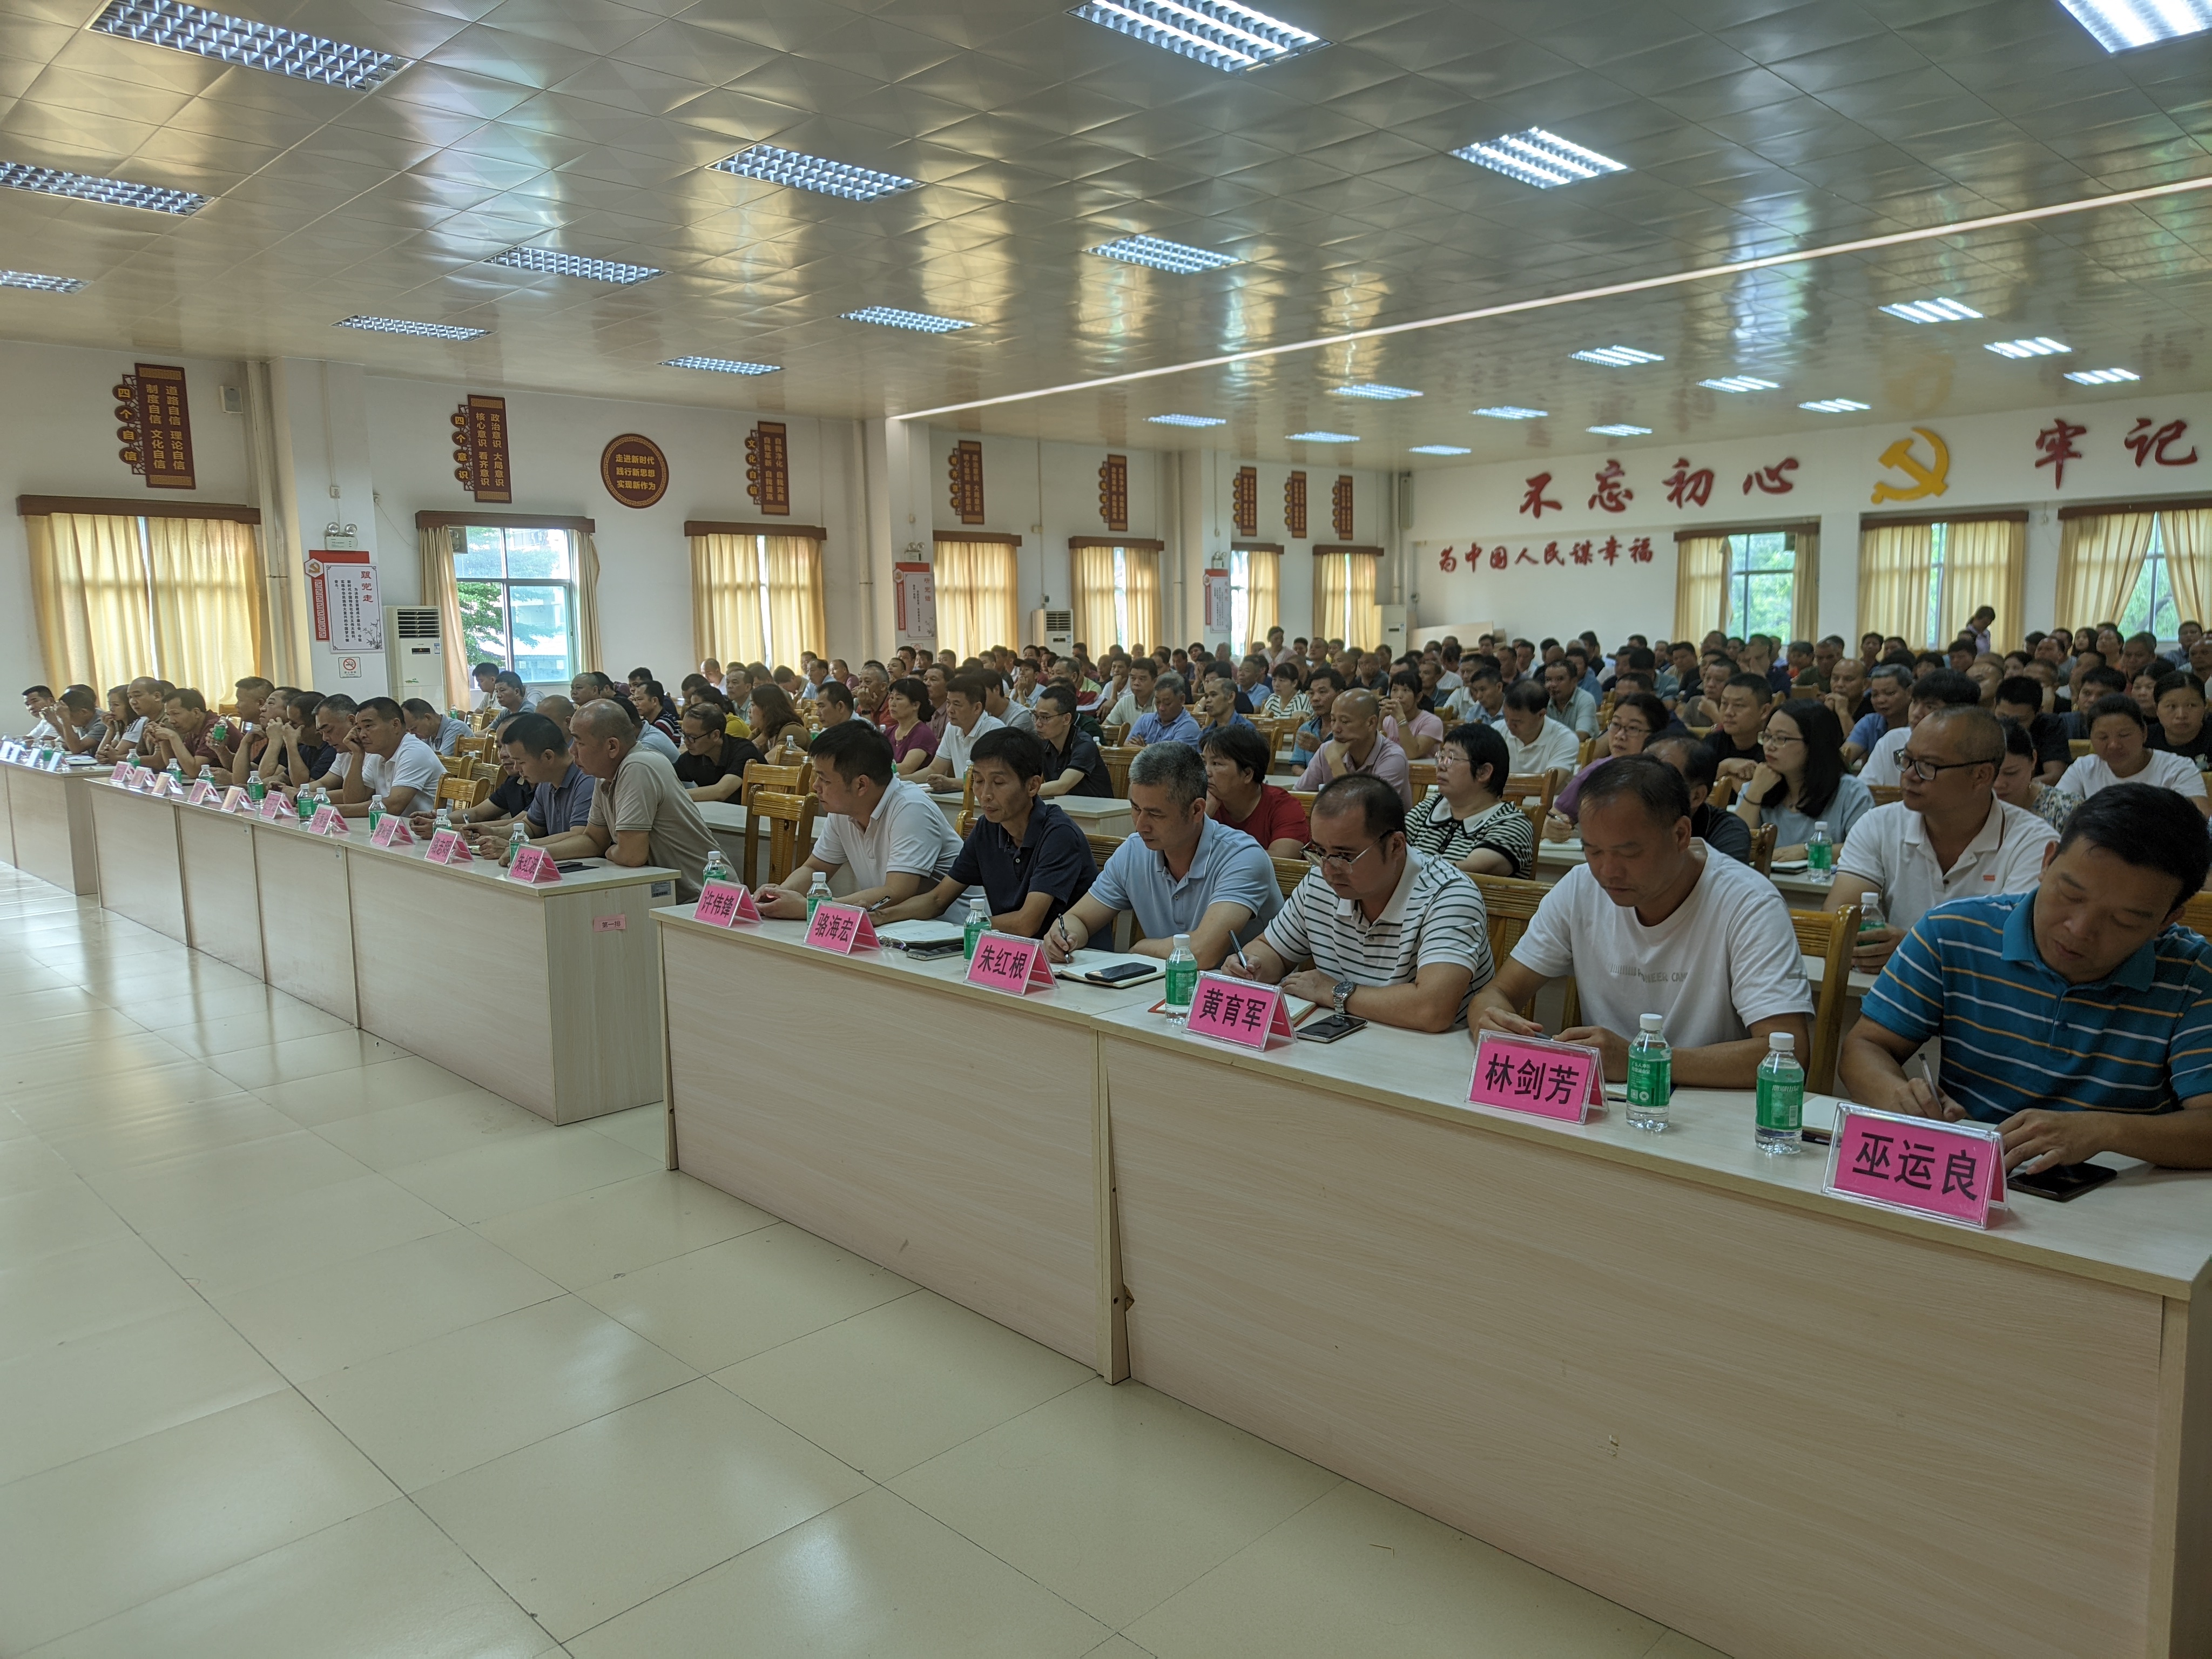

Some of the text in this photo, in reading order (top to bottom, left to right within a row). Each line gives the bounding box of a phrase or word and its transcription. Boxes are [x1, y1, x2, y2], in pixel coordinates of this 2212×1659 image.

[117, 388, 137, 461] 四个自信
[145, 383, 166, 469] 制度自信 文化自信
[165, 386, 185, 470] 道路自信 理论自信
[455, 416, 468, 480] 四个意识
[476, 412, 490, 486] 核心意识 看齐意识
[490, 413, 504, 487] 政治意识 大局意识
[615, 454, 655, 465] 走进新时代
[616, 467, 656, 477] 践行新思想
[2034, 417, 2198, 490] 牢记
[617, 480, 656, 490] 实现新作为
[1519, 457, 1799, 520] 不忘初心
[1438, 535, 1654, 573] 为中国人民谋幸福
[360, 571, 374, 603] 跟党走
[602, 920, 621, 928] 第一排
[701, 890, 735, 918] 许伟锋
[814, 913, 854, 942] 骆海宏
[977, 945, 1028, 979] 朱红根
[1199, 987, 1267, 1032] 黄育军
[1485, 1053, 1580, 1104] 林剑芳
[1852, 1131, 1978, 1202] 巫运良
